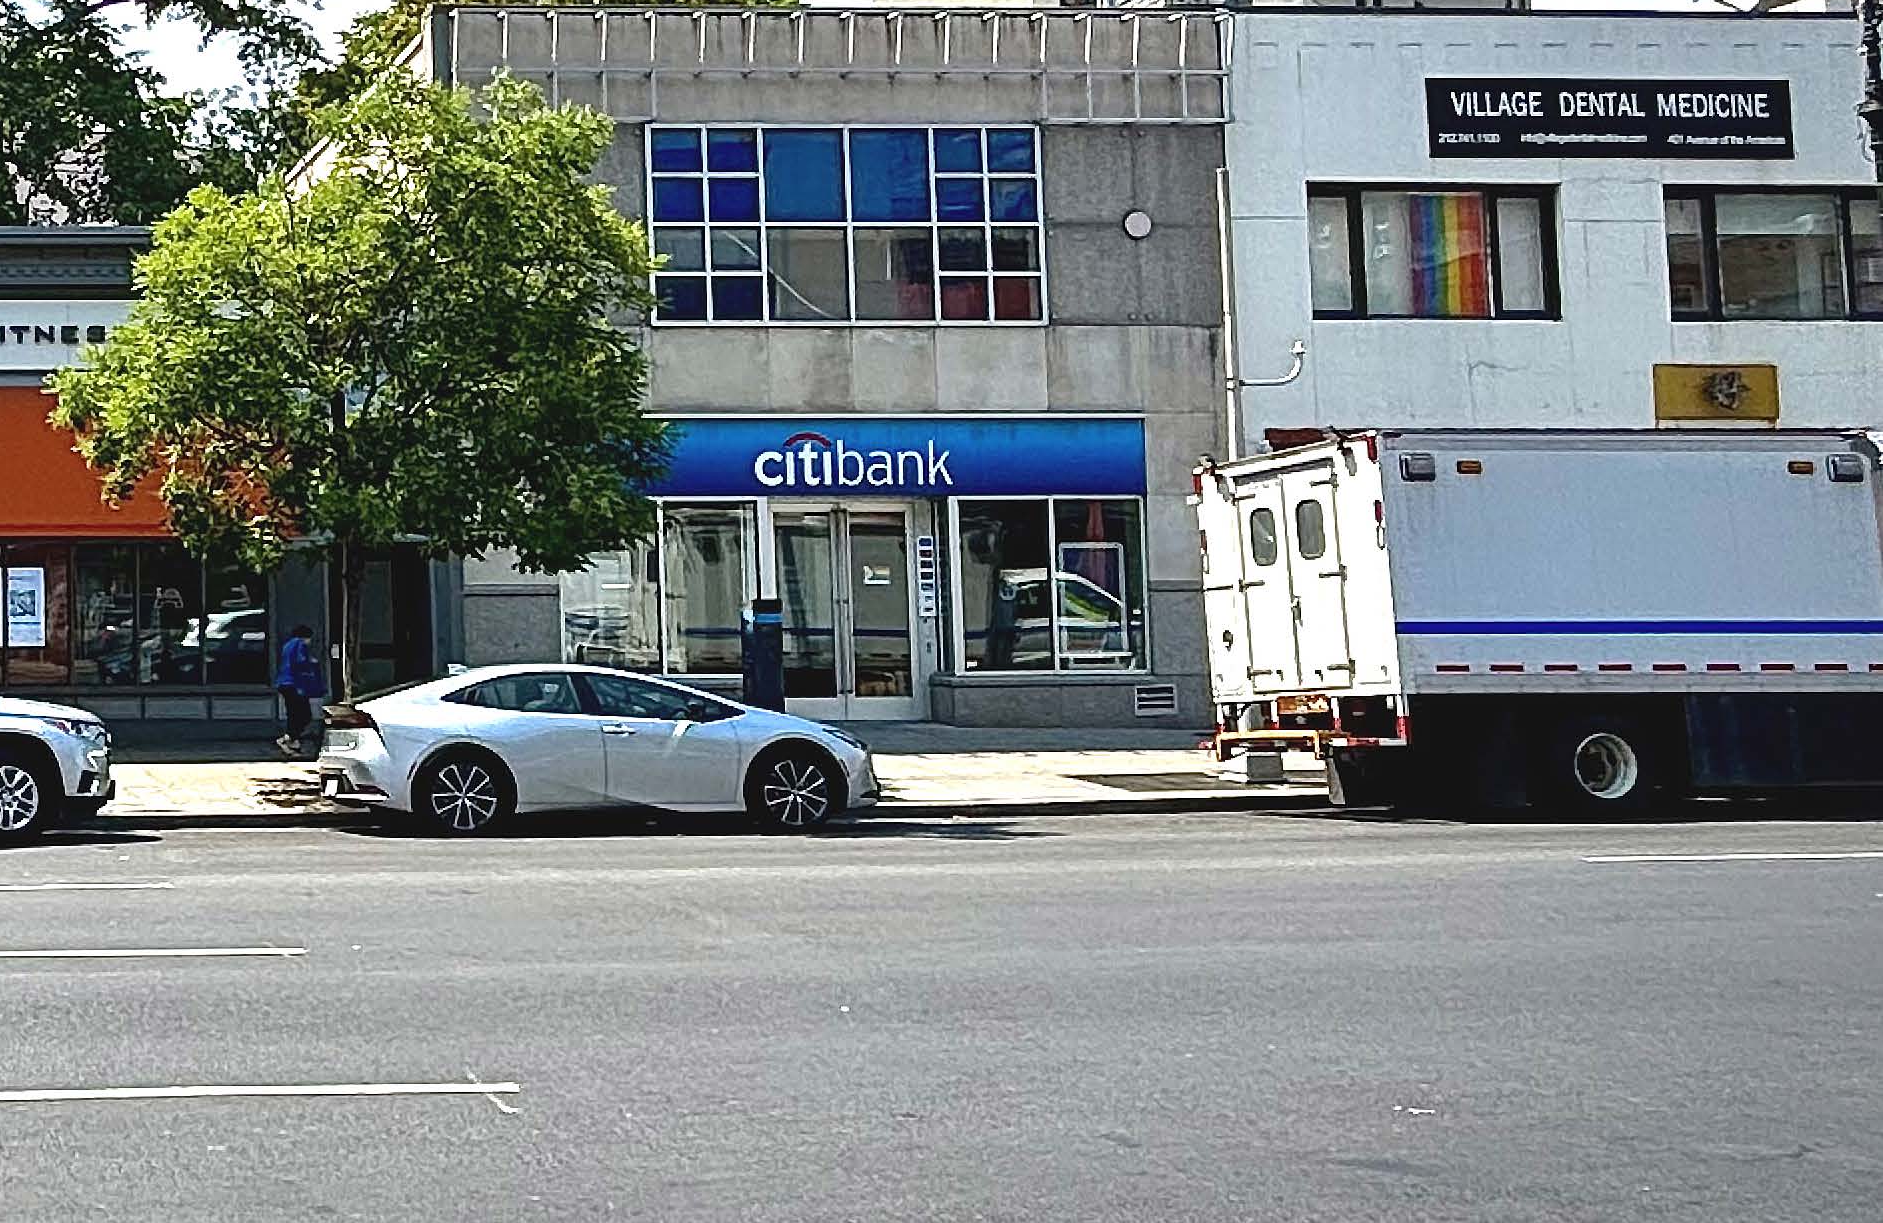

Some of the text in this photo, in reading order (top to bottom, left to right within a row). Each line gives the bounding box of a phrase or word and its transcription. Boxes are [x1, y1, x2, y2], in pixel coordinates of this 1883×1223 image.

[1450, 91, 1770, 118] VILLAGE DENTAL MEDICINE
[754, 436, 954, 487] citibank
